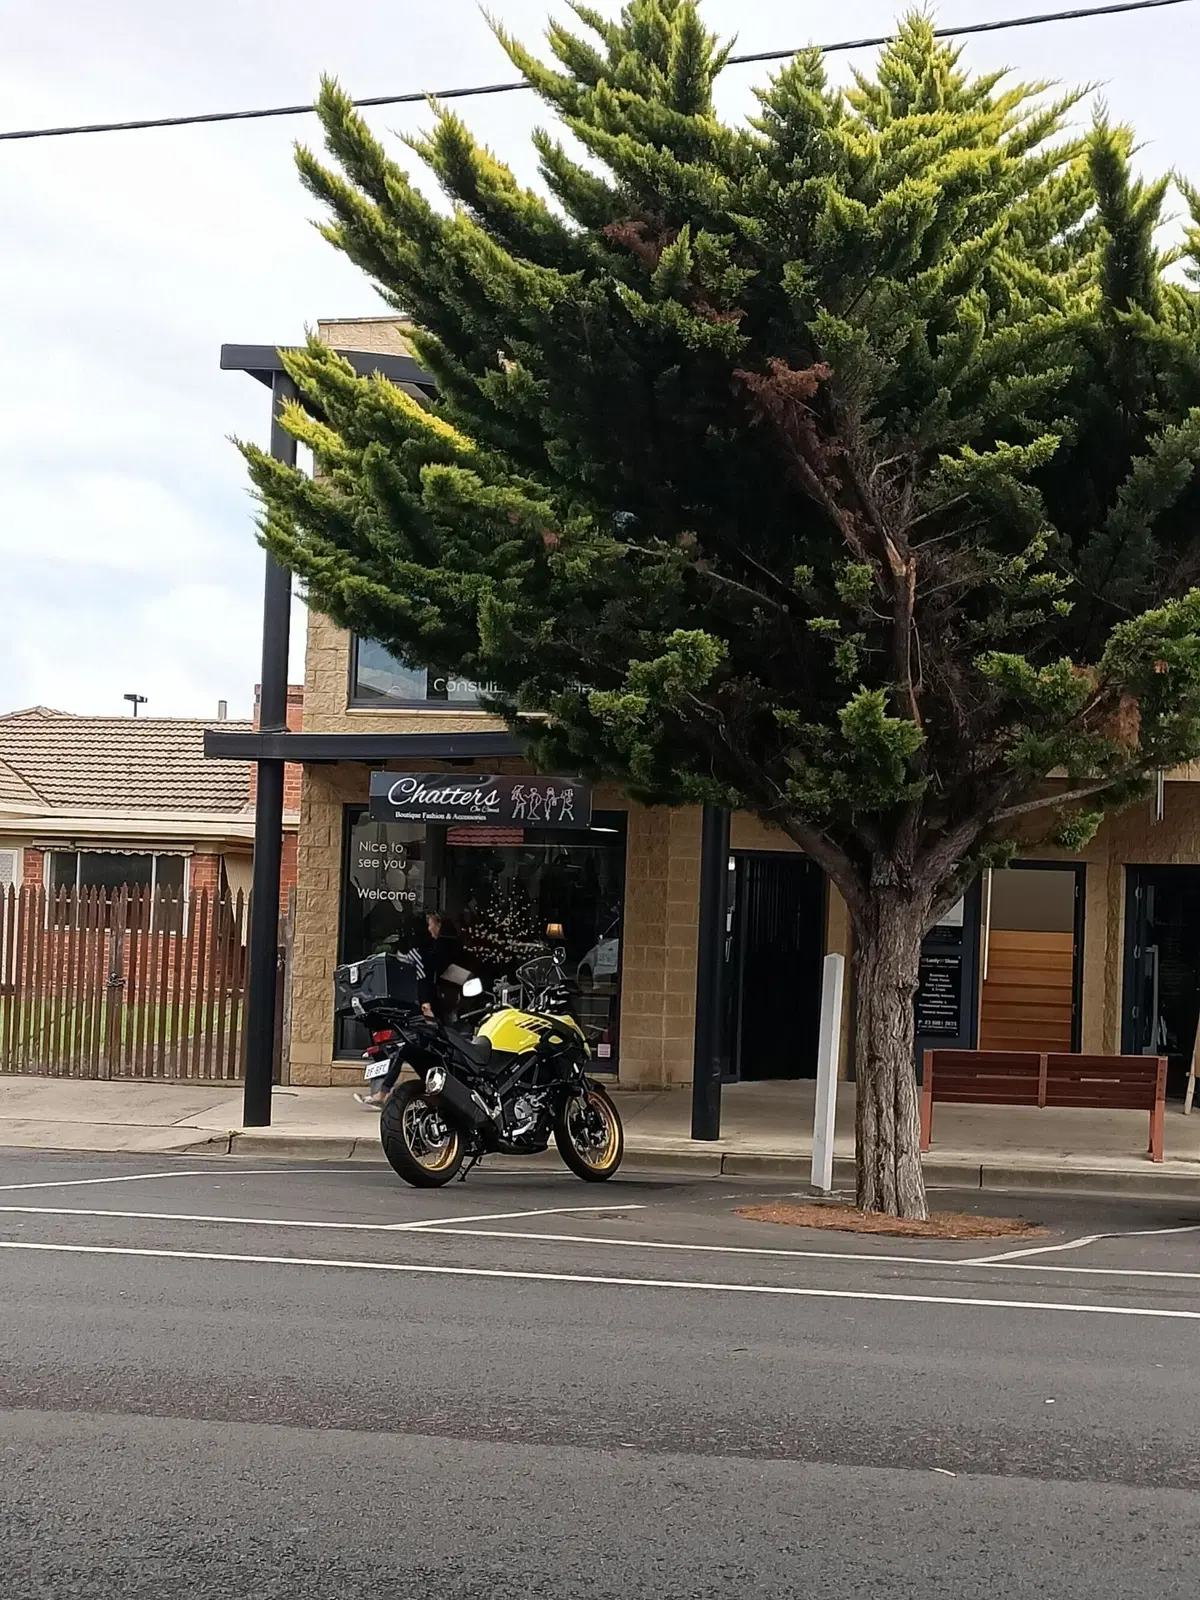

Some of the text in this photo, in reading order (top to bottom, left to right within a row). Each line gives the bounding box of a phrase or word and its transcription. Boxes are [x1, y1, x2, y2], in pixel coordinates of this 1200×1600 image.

[388, 777, 500, 805] Chatters
[422, 812, 445, 820] Fashion
[359, 841, 404, 853] Nice to
[358, 858, 406, 871] see you
[357, 888, 416, 901] Welcome
